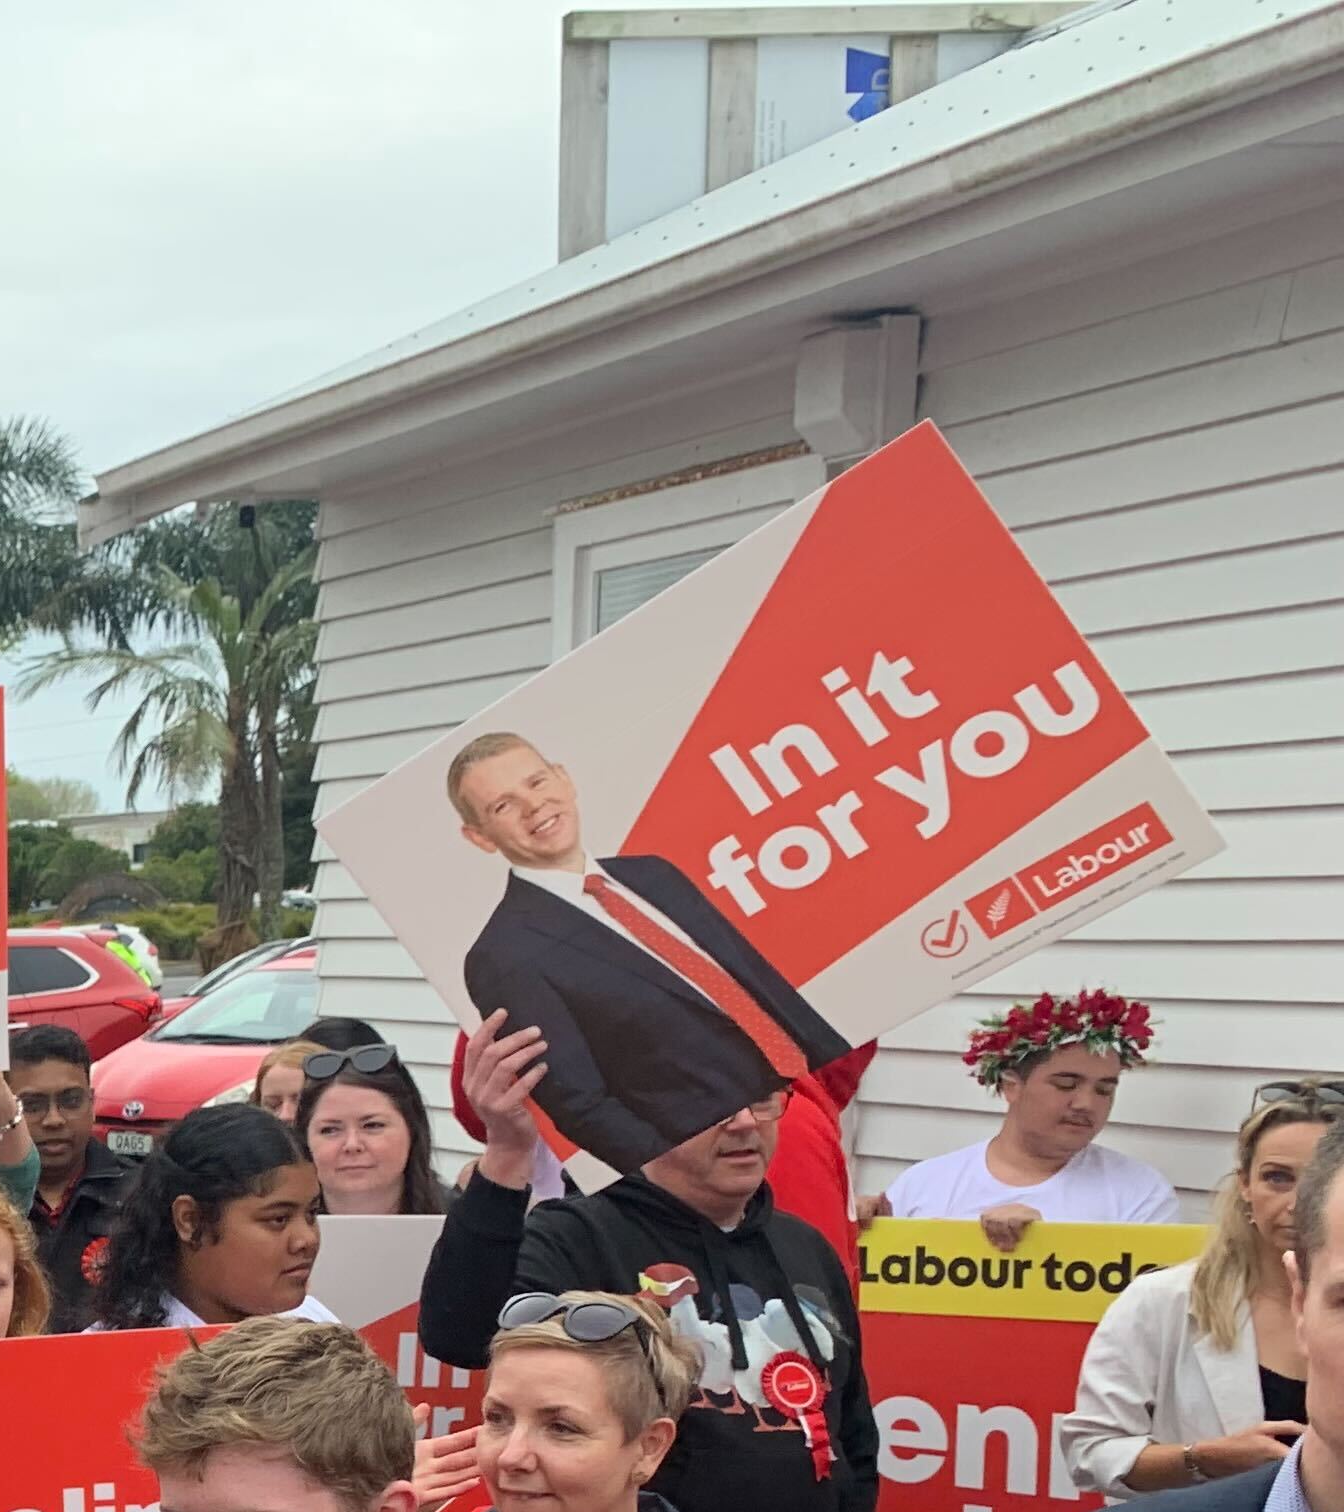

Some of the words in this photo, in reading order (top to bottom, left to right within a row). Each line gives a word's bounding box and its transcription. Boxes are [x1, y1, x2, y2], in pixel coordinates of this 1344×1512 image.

[706, 790, 870, 917] for
[874, 660, 1100, 840] you
[710, 723, 839, 816] In
[821, 650, 941, 747] it
[1033, 821, 1153, 899] Labour
[858, 1245, 1032, 1292] Labour
